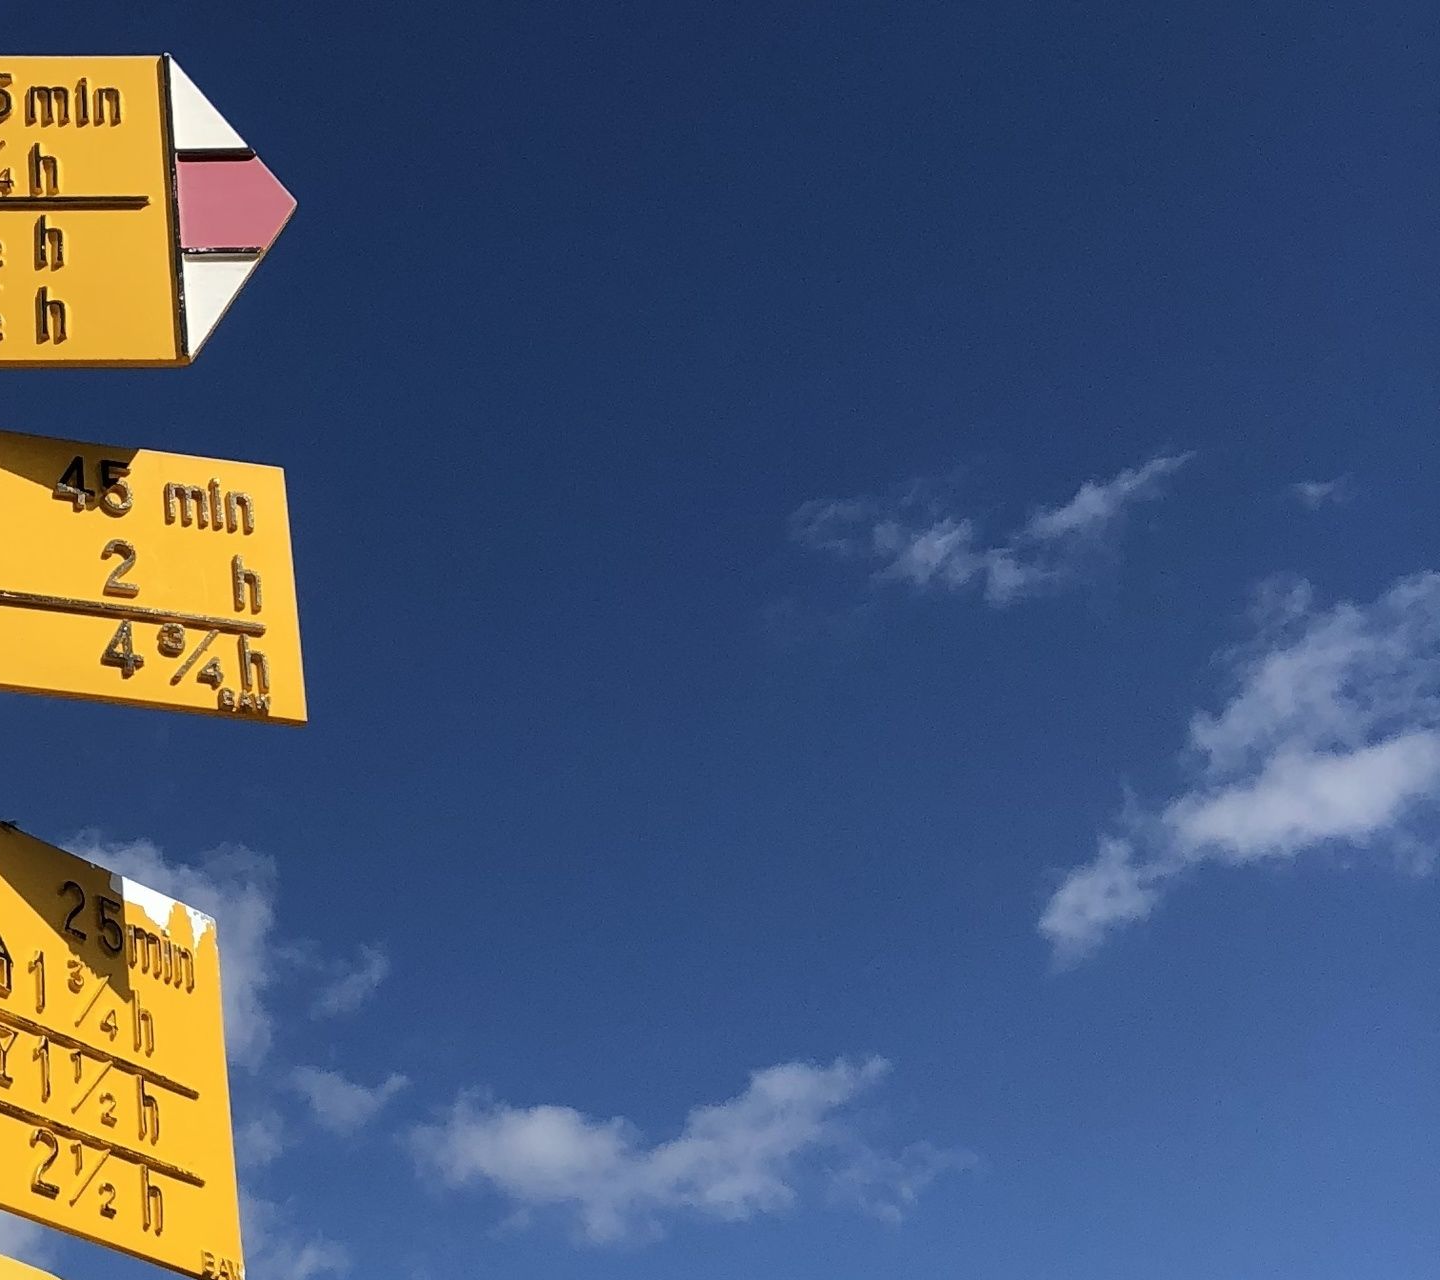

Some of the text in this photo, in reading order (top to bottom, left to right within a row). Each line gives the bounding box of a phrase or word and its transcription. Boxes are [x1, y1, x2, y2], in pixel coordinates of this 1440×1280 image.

[30, 142, 61, 195] h
[34, 215, 65, 269] h
[35, 286, 67, 344] h
[53, 456, 134, 517] 45
[164, 478, 255, 535] min
[101, 539, 140, 598] 2
[233, 554, 262, 614] h
[238, 634, 270, 693] h
[133, 990, 155, 1057] h
[136, 1074, 160, 1145] h
[143, 1164, 164, 1236] h
